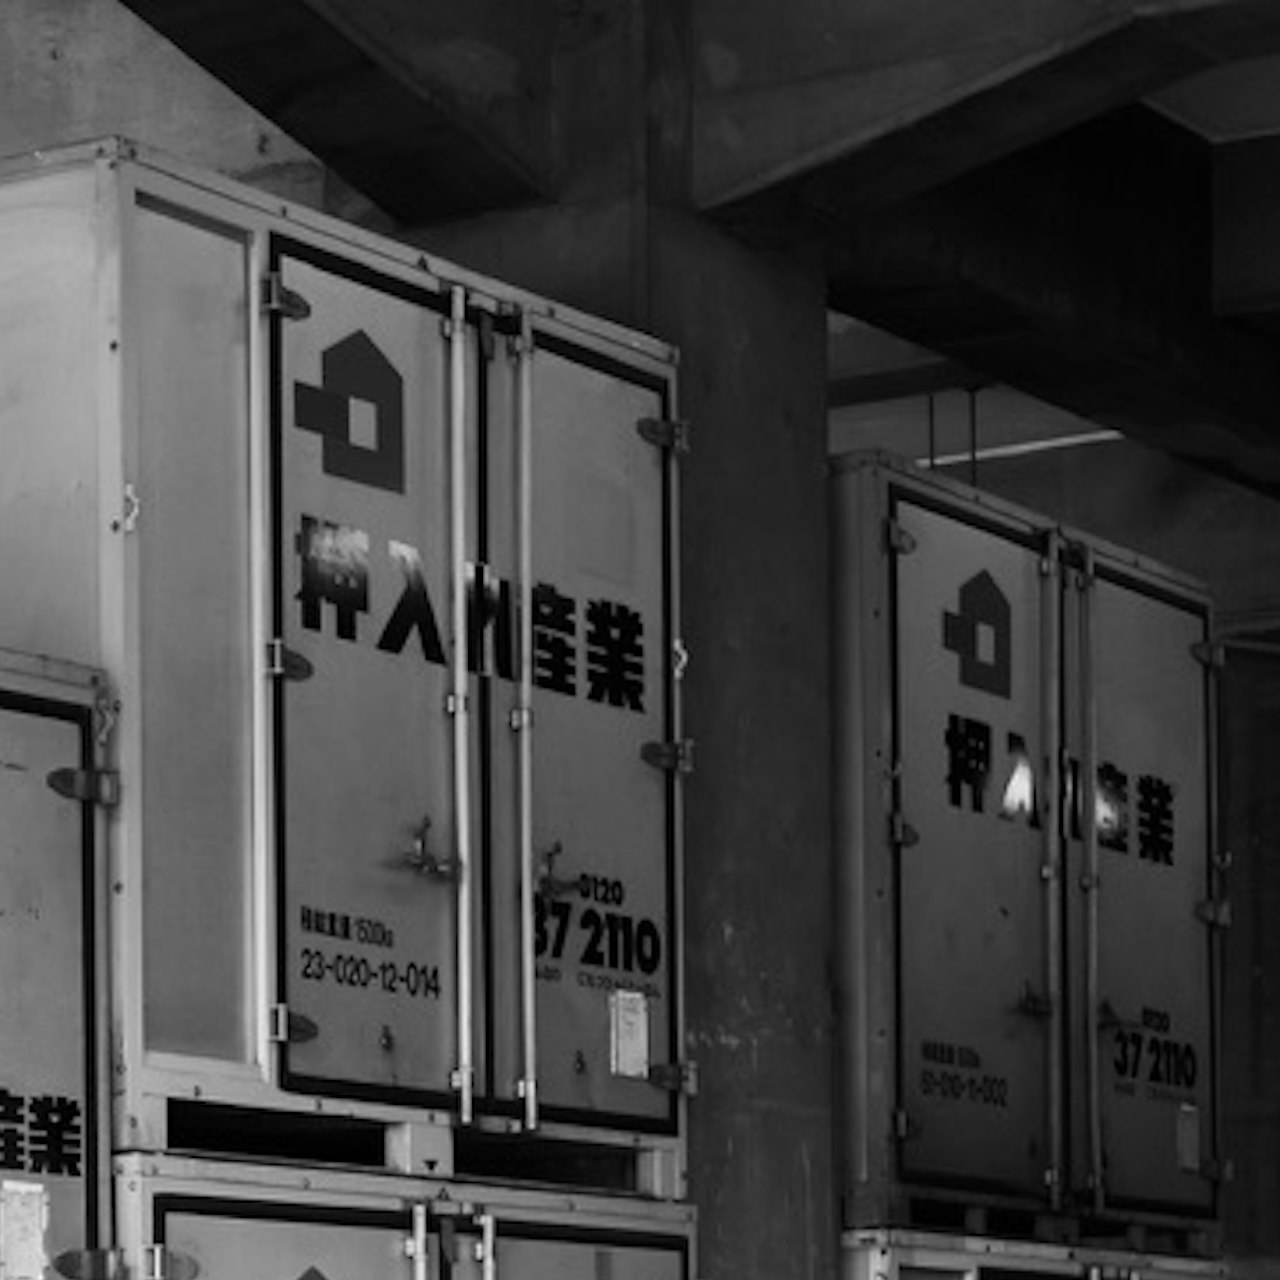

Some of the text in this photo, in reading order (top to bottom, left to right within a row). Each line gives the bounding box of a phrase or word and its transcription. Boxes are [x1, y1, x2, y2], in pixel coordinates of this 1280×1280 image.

[295, 513, 645, 713] 押入れ産業
[581, 873, 624, 905] 0120
[581, 908, 660, 974] 2110
[301, 946, 441, 1000] 23-020-12-014
[1148, 1037, 1196, 1089] 2110
